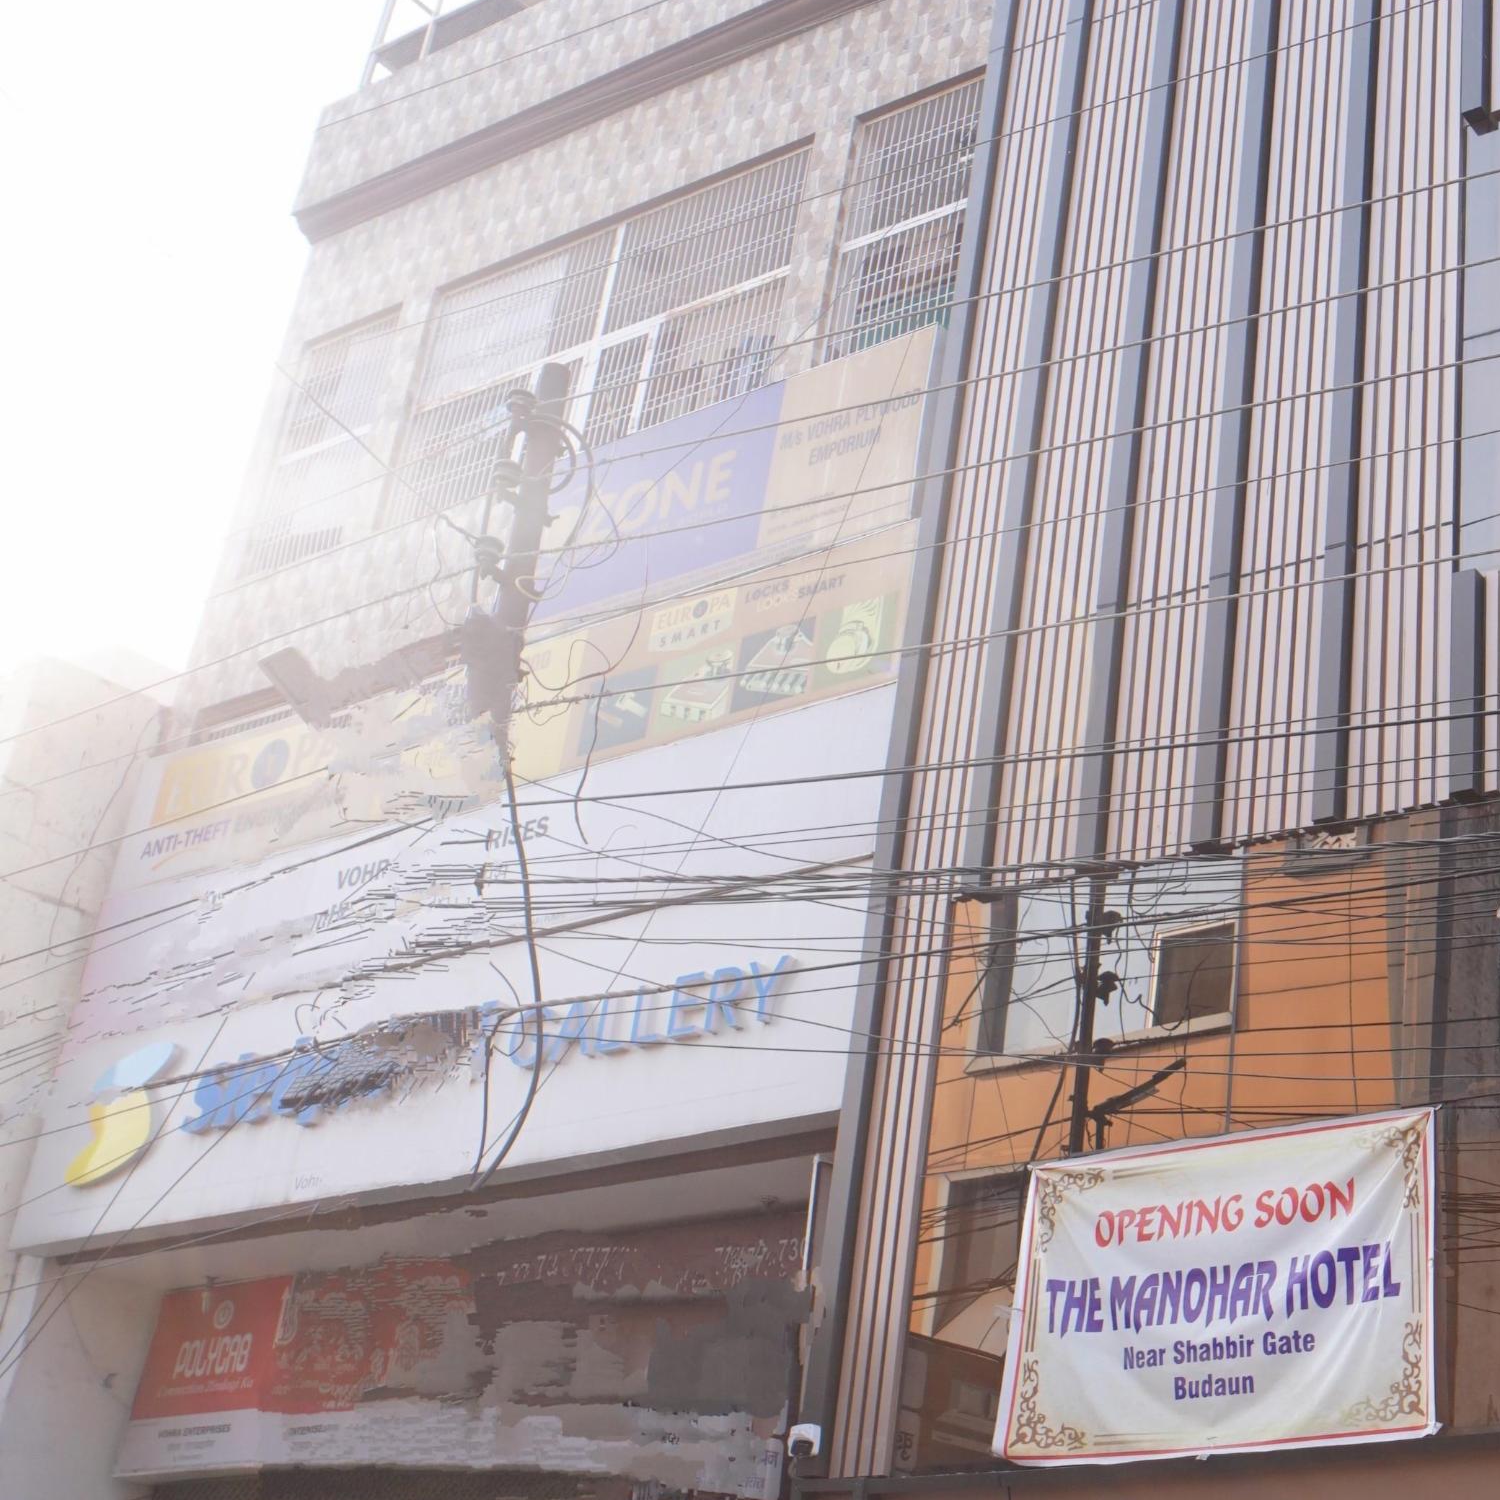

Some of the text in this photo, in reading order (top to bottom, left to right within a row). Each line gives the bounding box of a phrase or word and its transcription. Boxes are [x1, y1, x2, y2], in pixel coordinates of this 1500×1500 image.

[807, 412, 850, 442] VOHRA
[808, 428, 881, 466] EMPORIUM
[744, 579, 790, 605] LOCKS
[797, 574, 847, 600] SMART
[656, 593, 731, 630] EUROPA
[659, 619, 721, 648] SMART
[140, 819, 232, 860] ANTI-THEFT
[337, 858, 391, 890] VOHR
[509, 954, 799, 1070] GALLERY
[1094, 1177, 1356, 1248] OPENING SOON
[1046, 1240, 1401, 1338] THE MANOHAR HOTEL
[171, 1332, 253, 1379] POLYCAB
[1123, 1330, 1316, 1370] Near Shabbir Gate
[1174, 1374, 1254, 1400] Budaun
